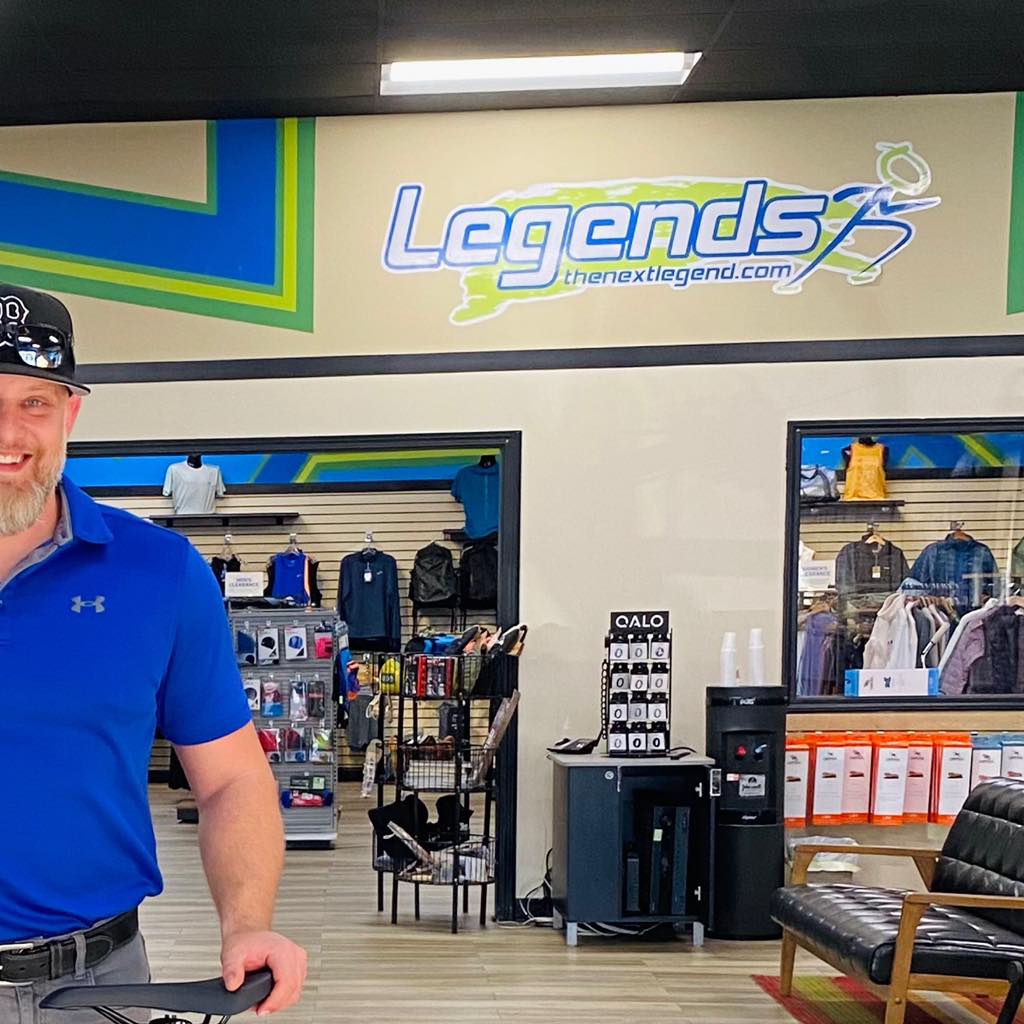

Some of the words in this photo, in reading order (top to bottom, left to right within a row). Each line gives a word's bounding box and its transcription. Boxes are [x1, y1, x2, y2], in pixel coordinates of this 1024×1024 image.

[384, 180, 828, 288] Legends
[563, 263, 792, 287] thenextlegend.com
[615, 615, 664, 629] QALO
